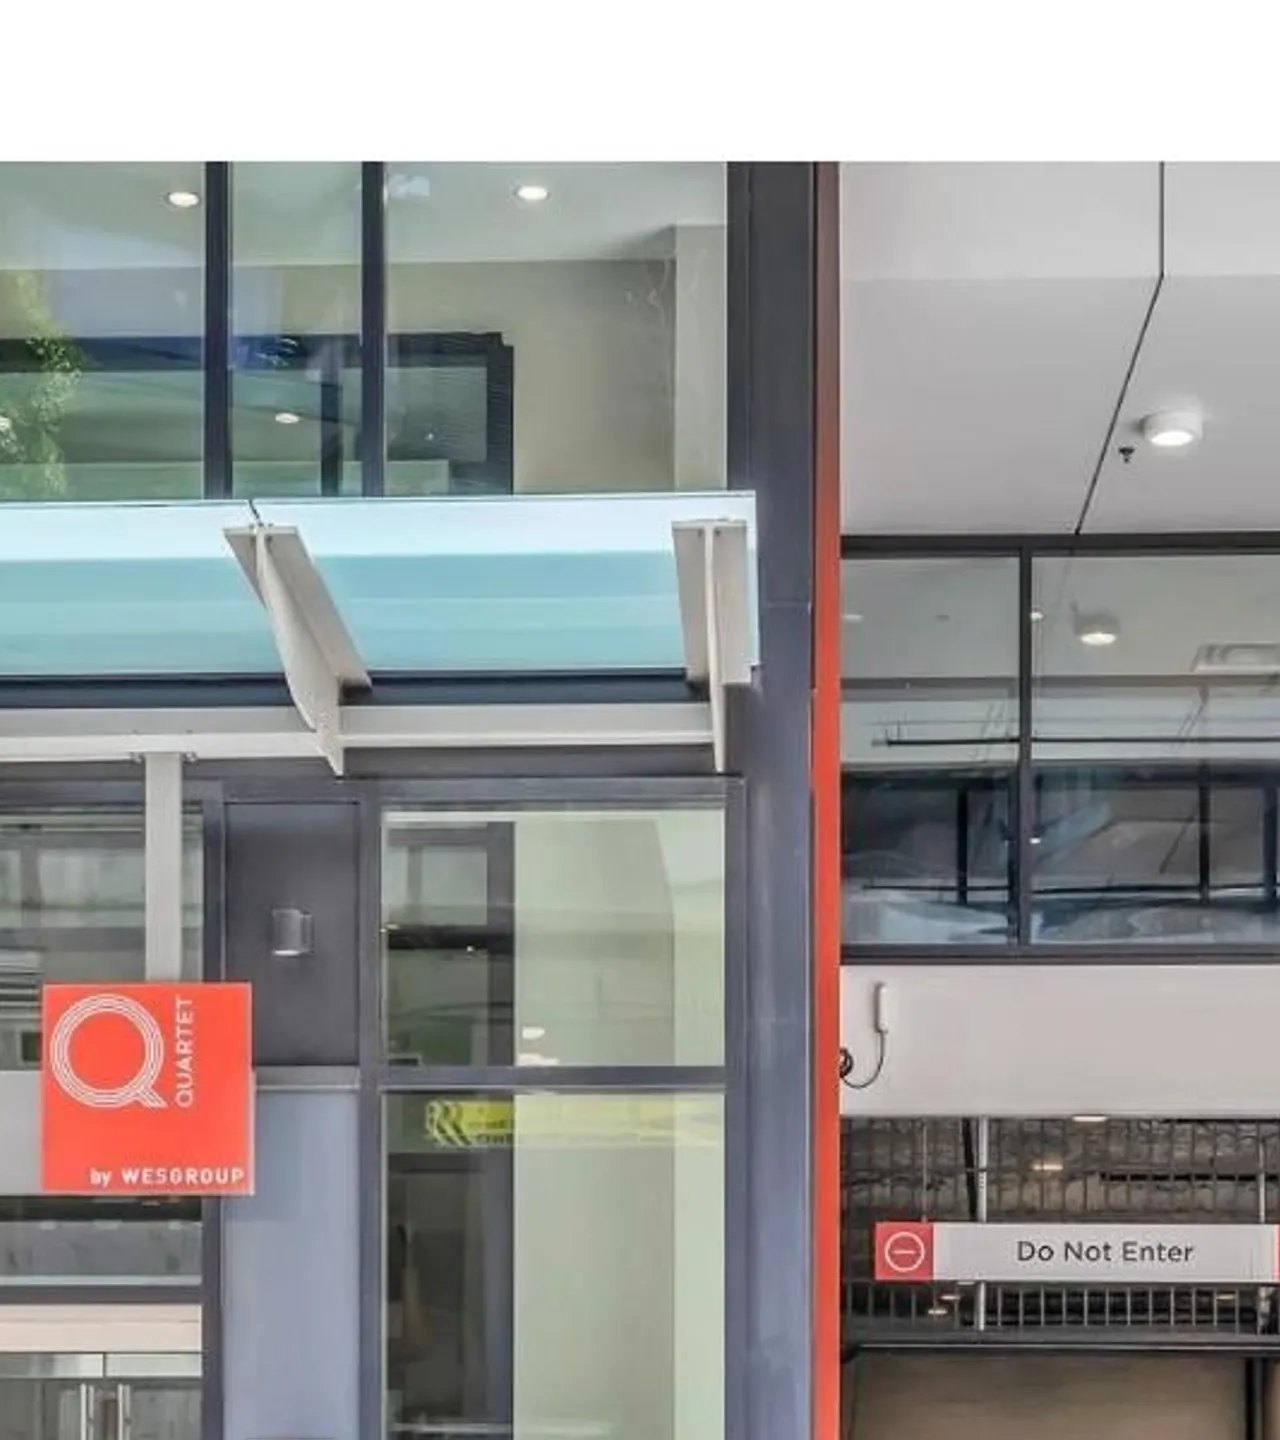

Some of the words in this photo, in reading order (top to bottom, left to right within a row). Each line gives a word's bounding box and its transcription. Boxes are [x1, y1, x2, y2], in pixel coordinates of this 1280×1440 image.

[49, 993, 168, 1109] Q
[175, 995, 195, 1108] QUARTET
[89, 1167, 112, 1188] by
[121, 1167, 245, 1185] WESGROUP
[1017, 1241, 1054, 1263] Do
[1064, 1241, 1112, 1263] Not
[1122, 1241, 1195, 1263] Enter
